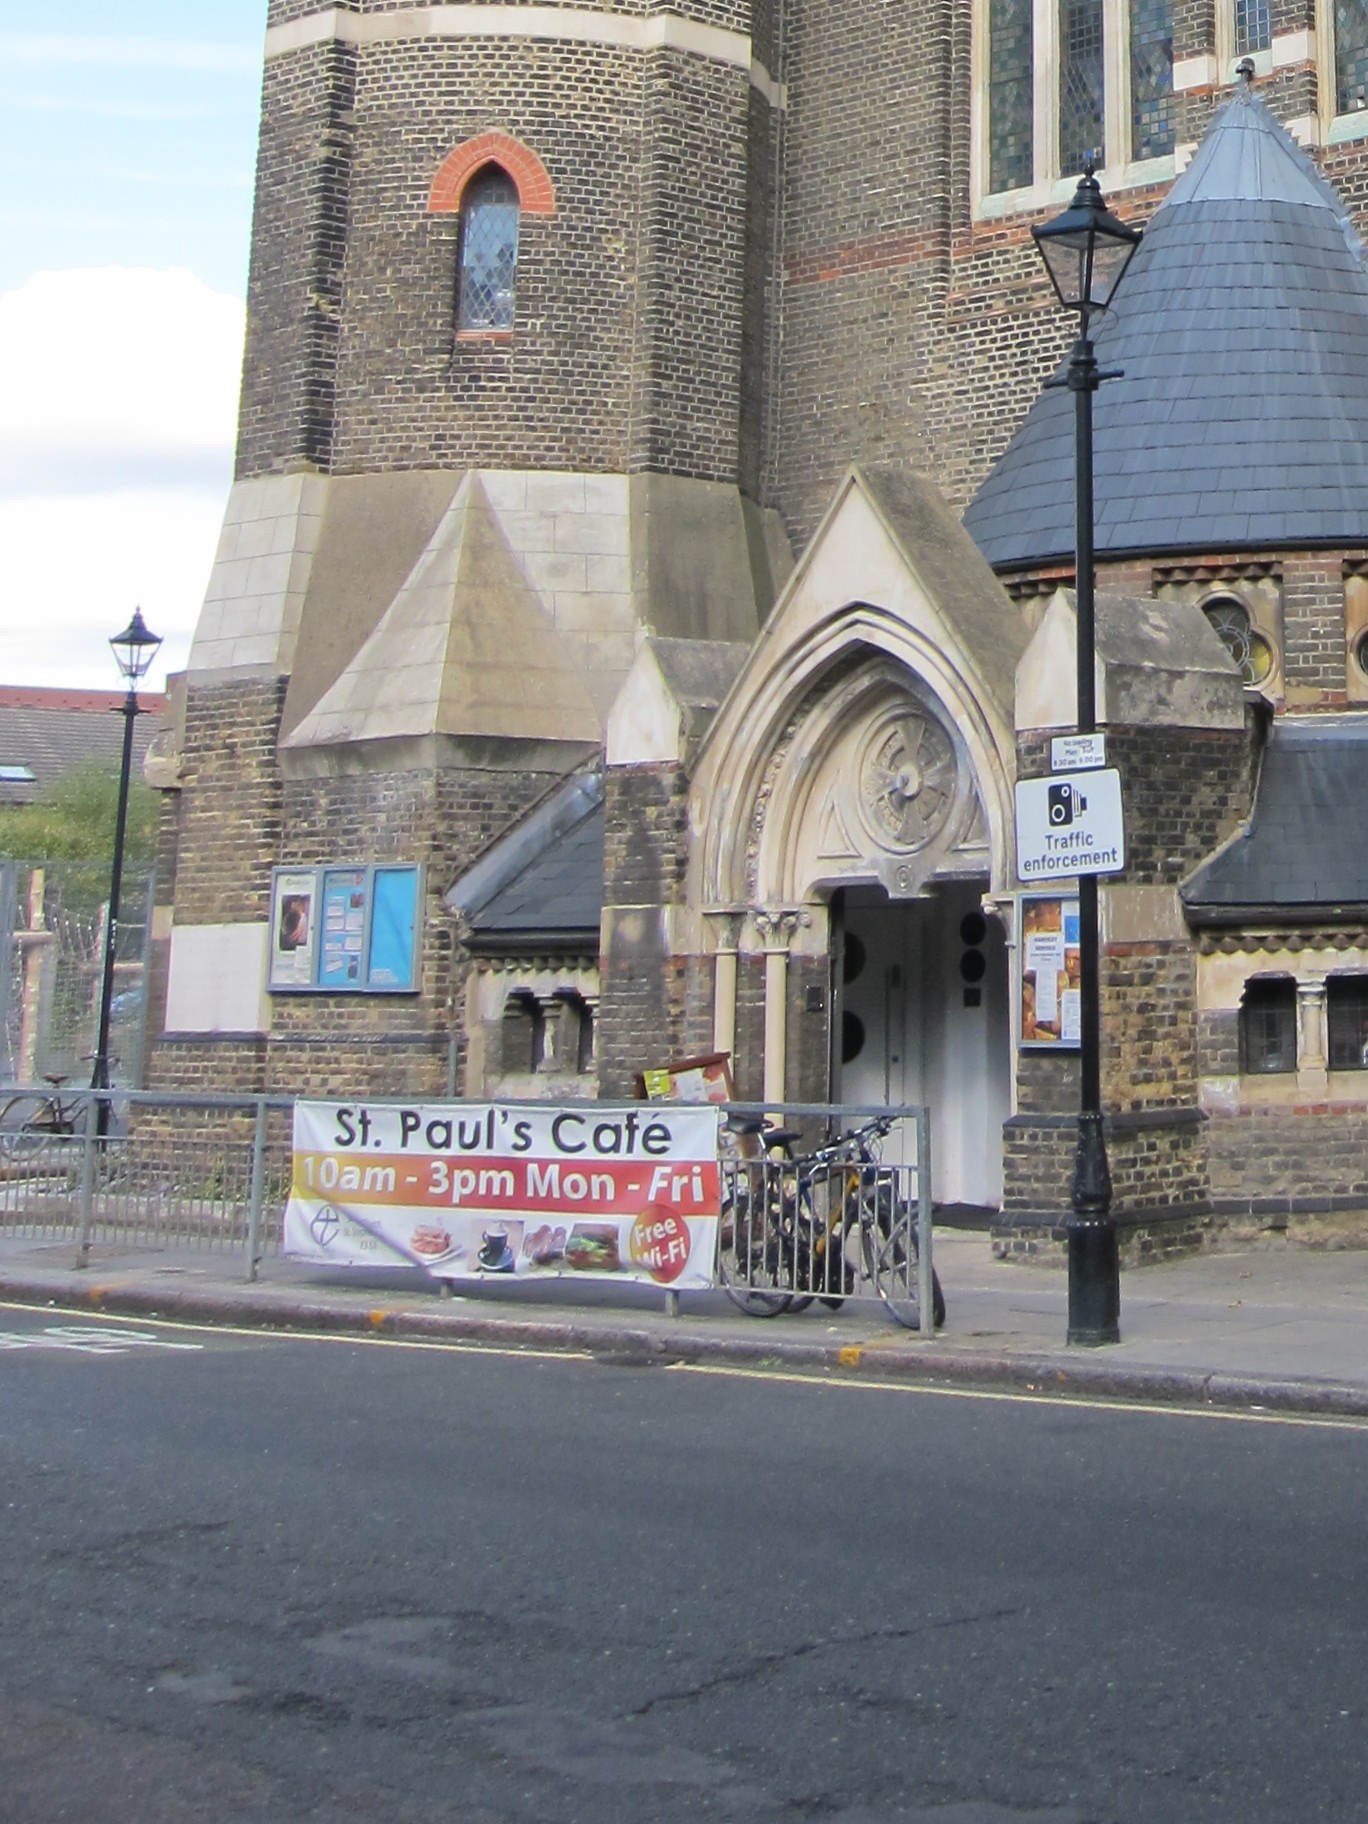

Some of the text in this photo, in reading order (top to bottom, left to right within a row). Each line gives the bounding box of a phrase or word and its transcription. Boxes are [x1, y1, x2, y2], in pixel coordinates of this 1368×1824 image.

[1045, 831, 1094, 851] Traffic
[1024, 847, 1118, 872] enforcement
[335, 1108, 672, 1155] St. Paul's Café
[304, 1157, 396, 1193] 10am
[428, 1160, 515, 1204] 3pm
[526, 1163, 615, 1201] Mon
[648, 1165, 704, 1202] Fri
[634, 1217, 678, 1247] Free
[636, 1237, 687, 1270] Wi-Fi
